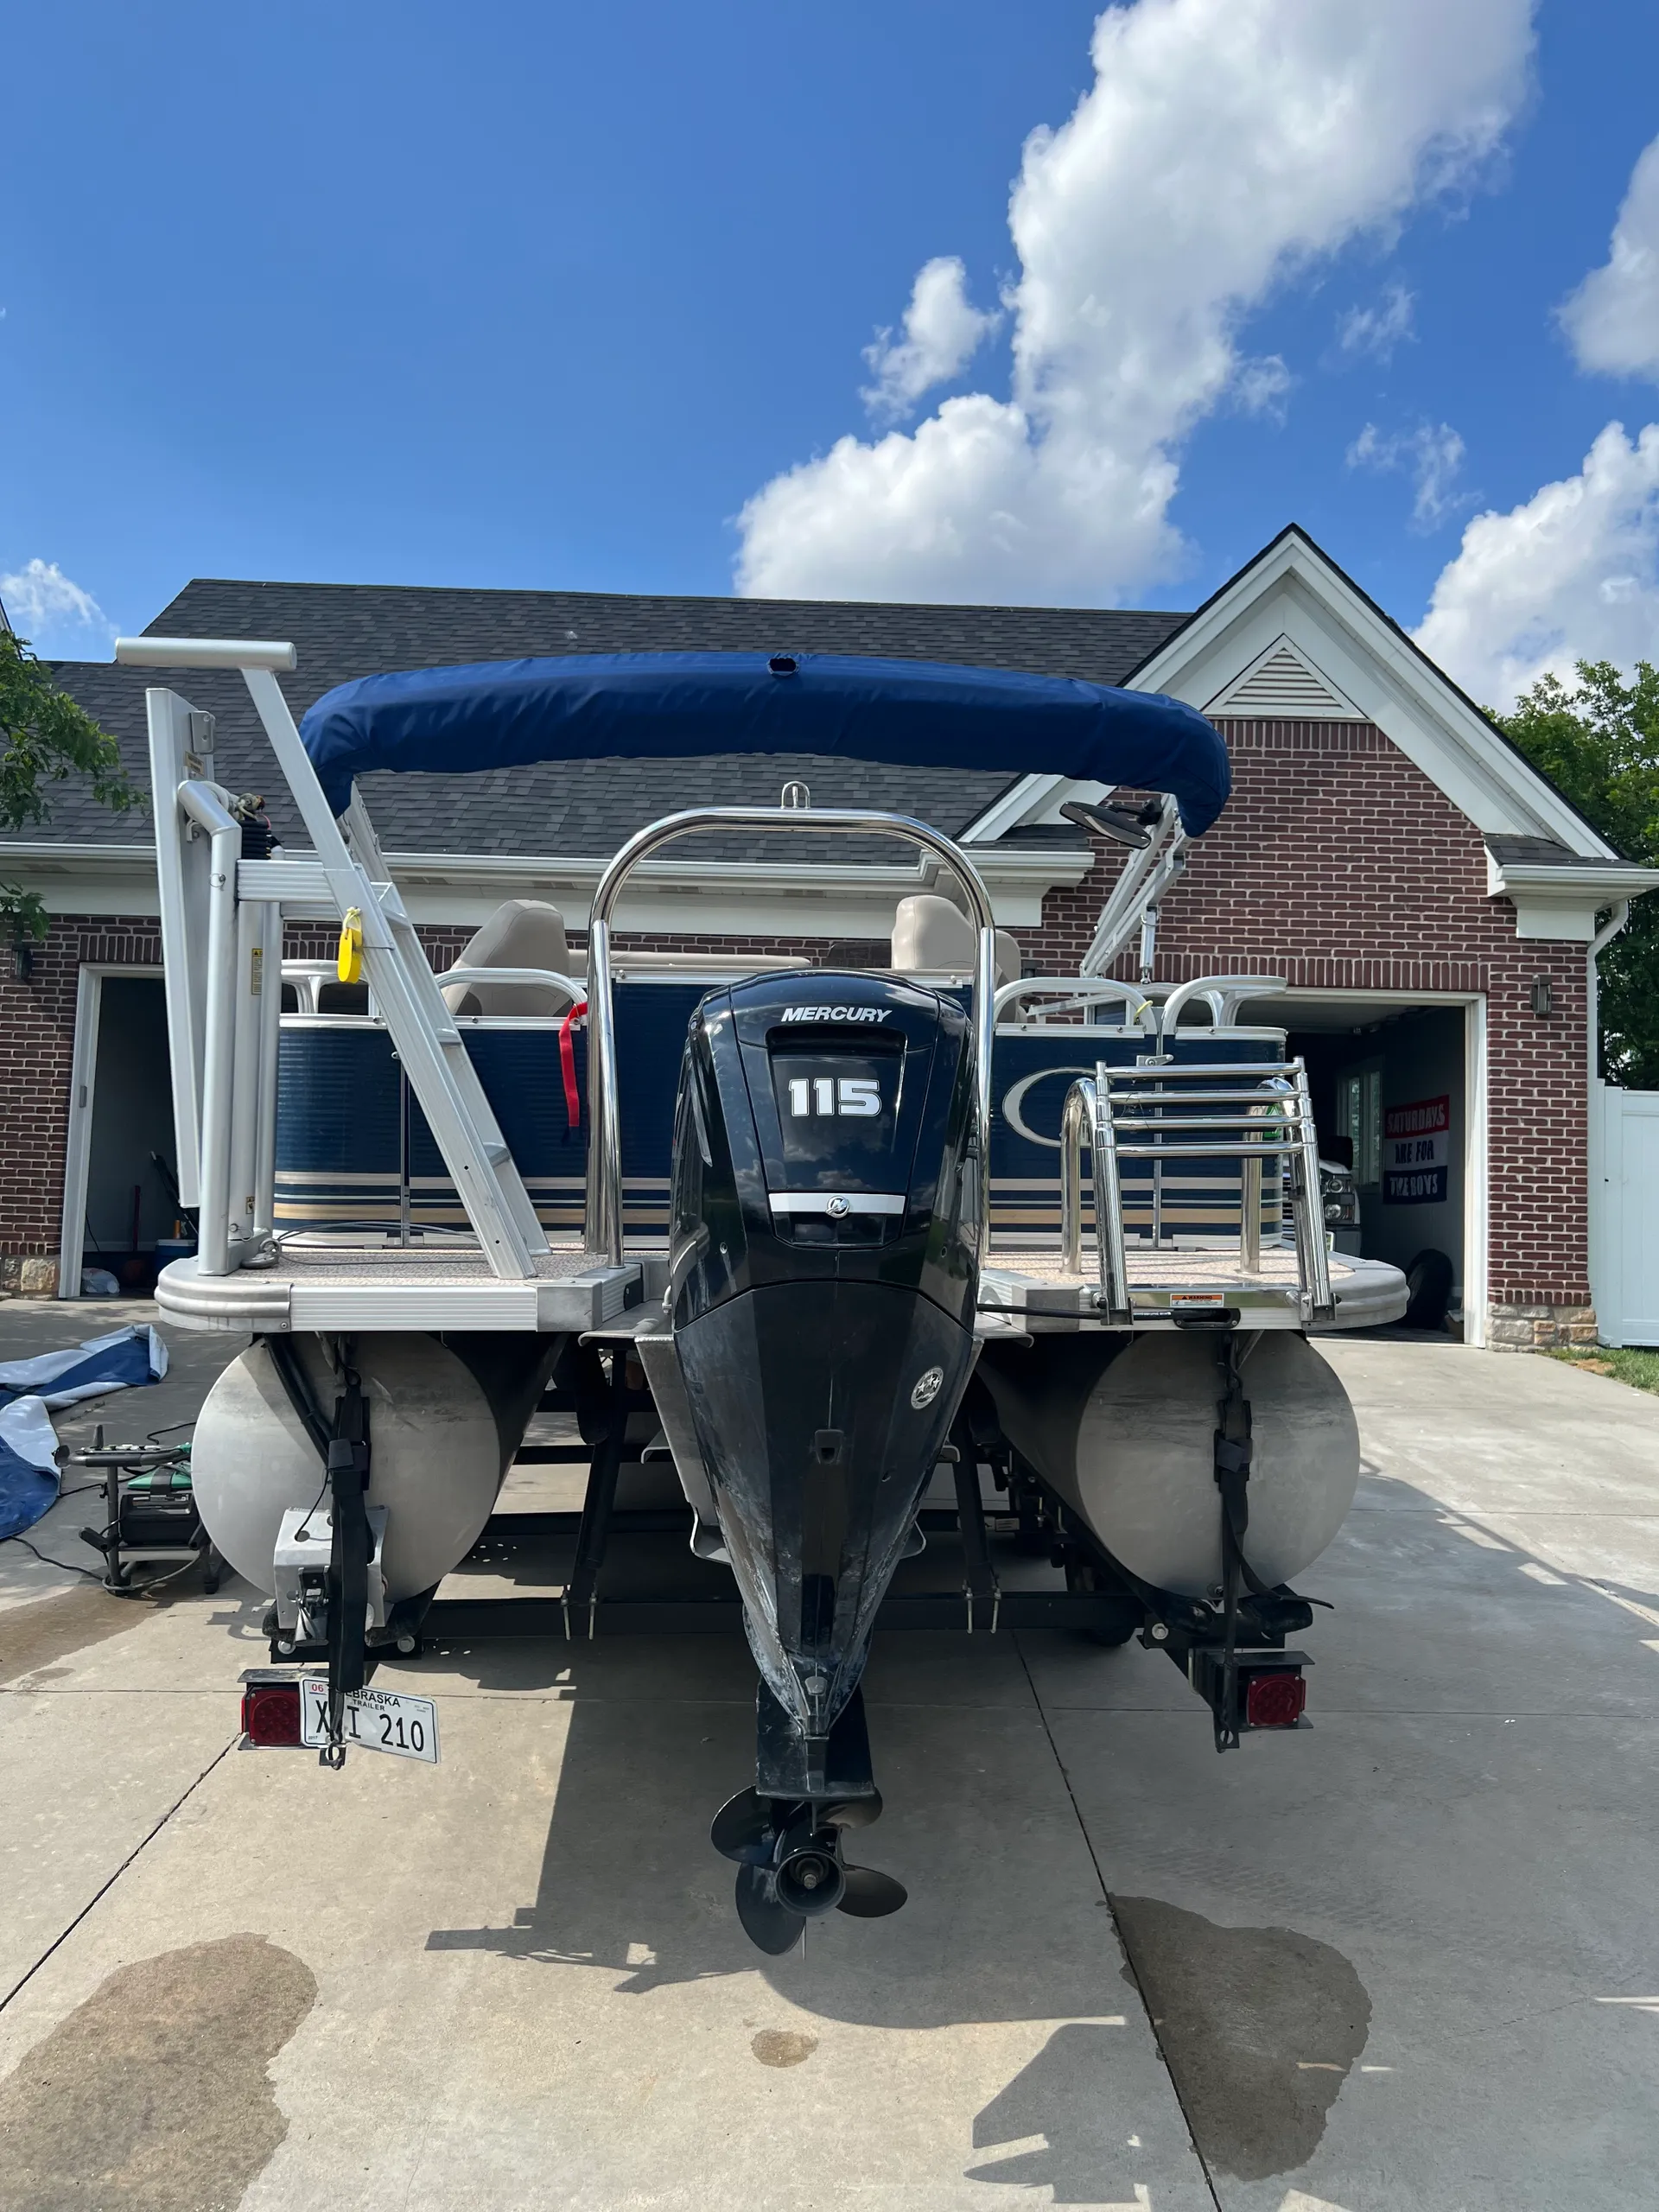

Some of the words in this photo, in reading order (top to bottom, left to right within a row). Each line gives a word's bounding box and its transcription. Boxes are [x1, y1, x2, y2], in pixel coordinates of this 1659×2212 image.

[781, 1007, 893, 1022] MERCURY
[788, 1077, 882, 1117] 115
[1387, 1103, 1446, 1134] SATURDAYS
[1395, 1142, 1413, 1164] ARE
[1415, 1140, 1434, 1162] FOR
[1389, 1176, 1409, 1197] THE
[1410, 1173, 1438, 1196] BOYS
[311, 1683, 324, 1693] 06
[345, 1689, 401, 1708] EBRASKA
[353, 1699, 385, 1712] TRAILER
[378, 1713, 425, 1752] 210
